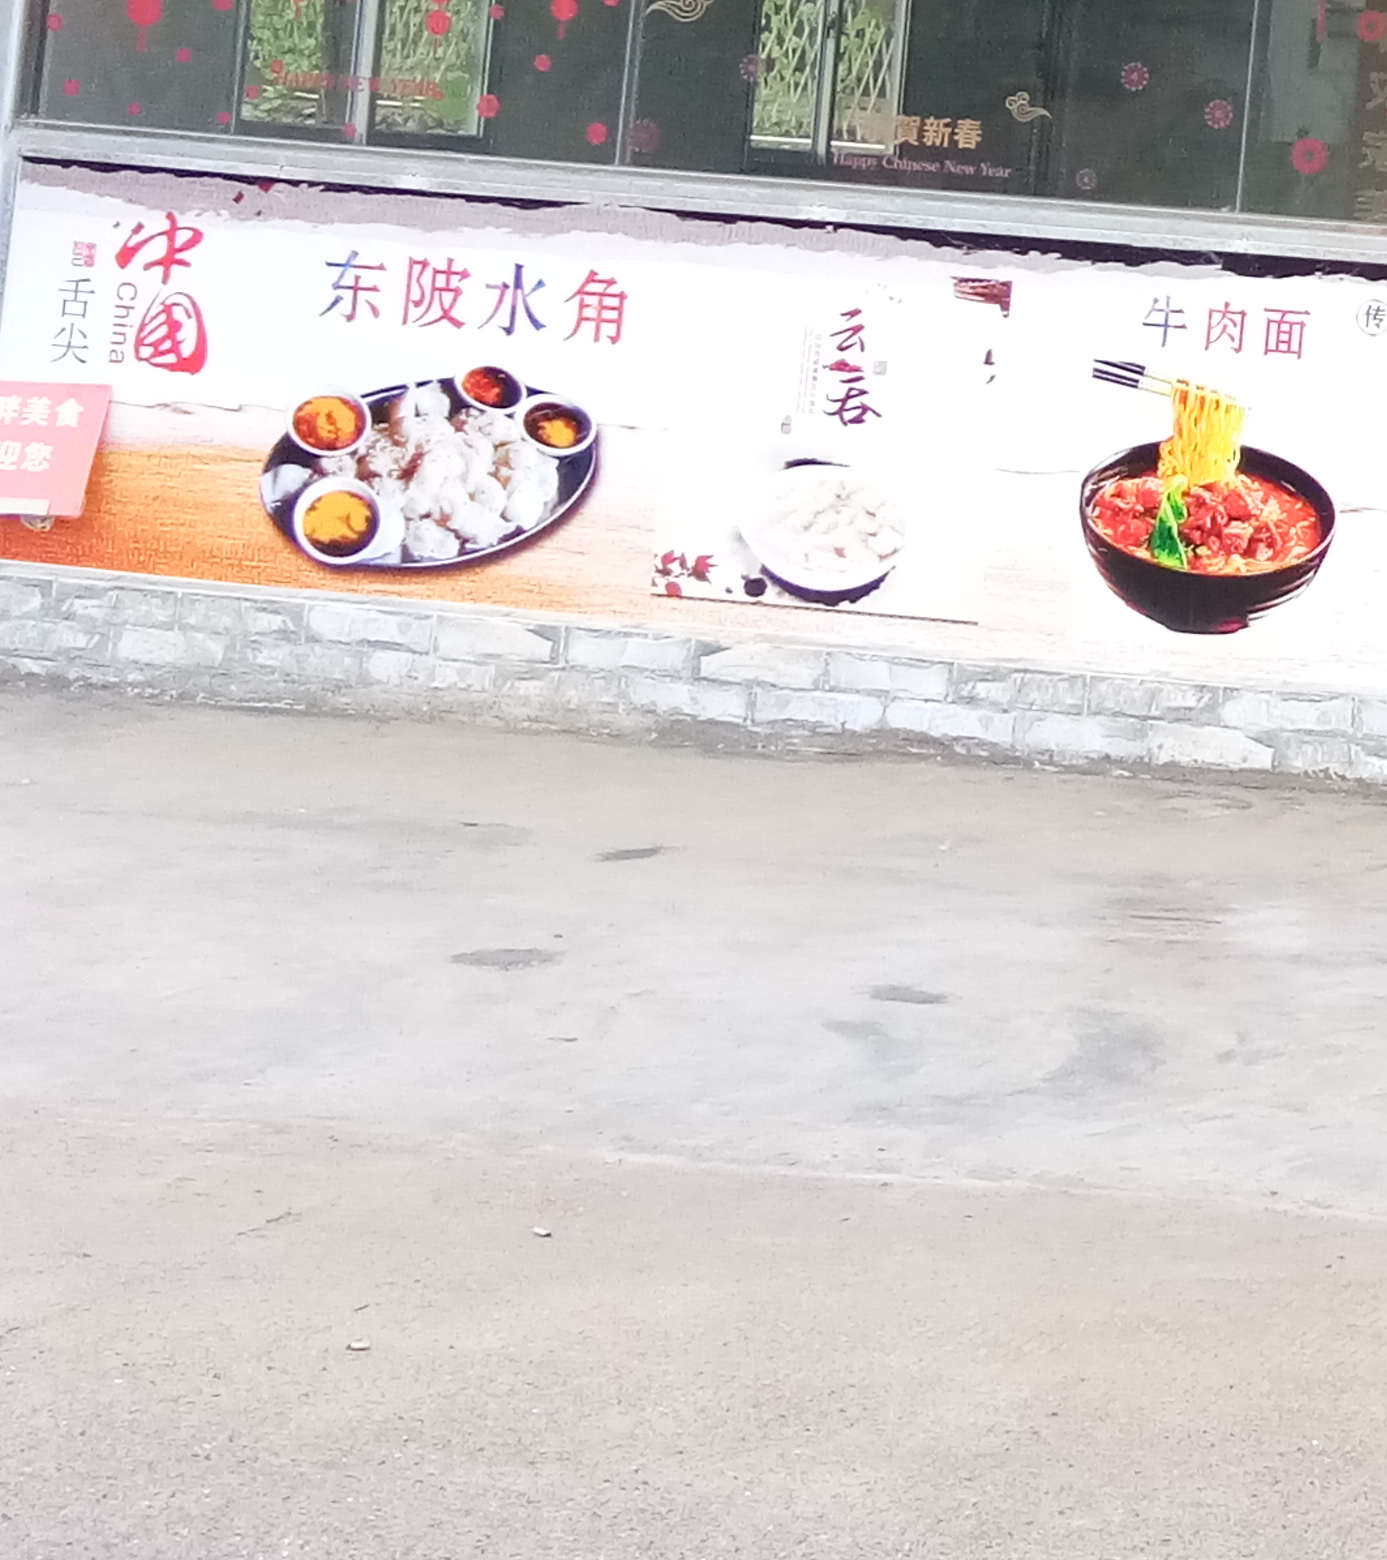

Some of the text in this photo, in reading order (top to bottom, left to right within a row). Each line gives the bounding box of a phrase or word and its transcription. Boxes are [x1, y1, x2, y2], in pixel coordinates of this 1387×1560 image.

[881, 154, 942, 175] Chinese
[943, 159, 977, 174] New
[980, 162, 1012, 178] Year
[50, 278, 97, 365] 舌尖
[107, 281, 139, 365] China
[319, 250, 629, 345] 东陂水角
[1142, 295, 1311, 361] 牛肉面
[822, 307, 883, 427] 云吞
